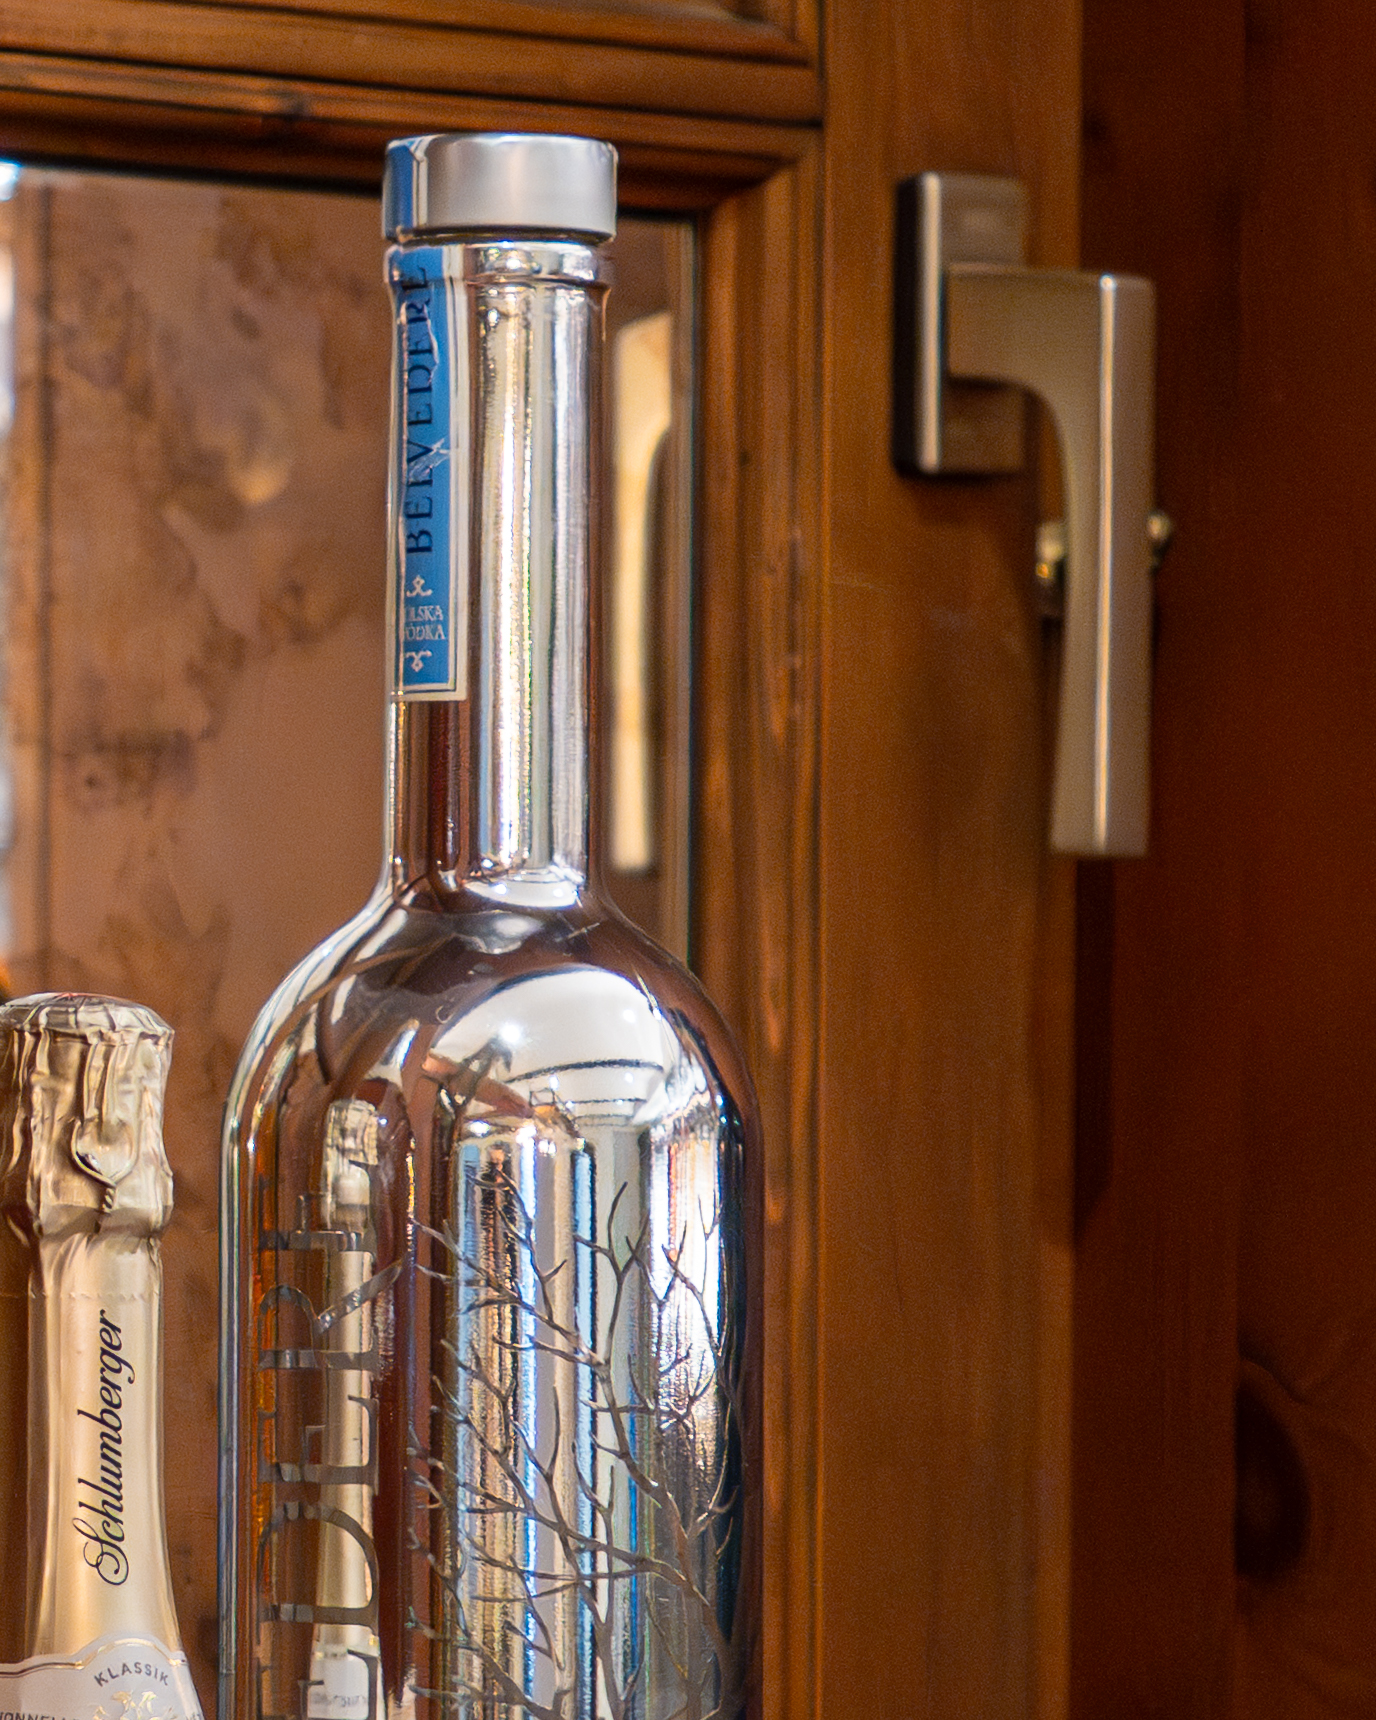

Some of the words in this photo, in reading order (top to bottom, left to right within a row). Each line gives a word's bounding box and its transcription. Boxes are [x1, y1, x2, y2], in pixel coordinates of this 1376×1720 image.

[402, 265, 435, 556] BELVEDERE
[71, 1308, 136, 1586] Schlumberger
[94, 1661, 169, 1687] KLASSIK
